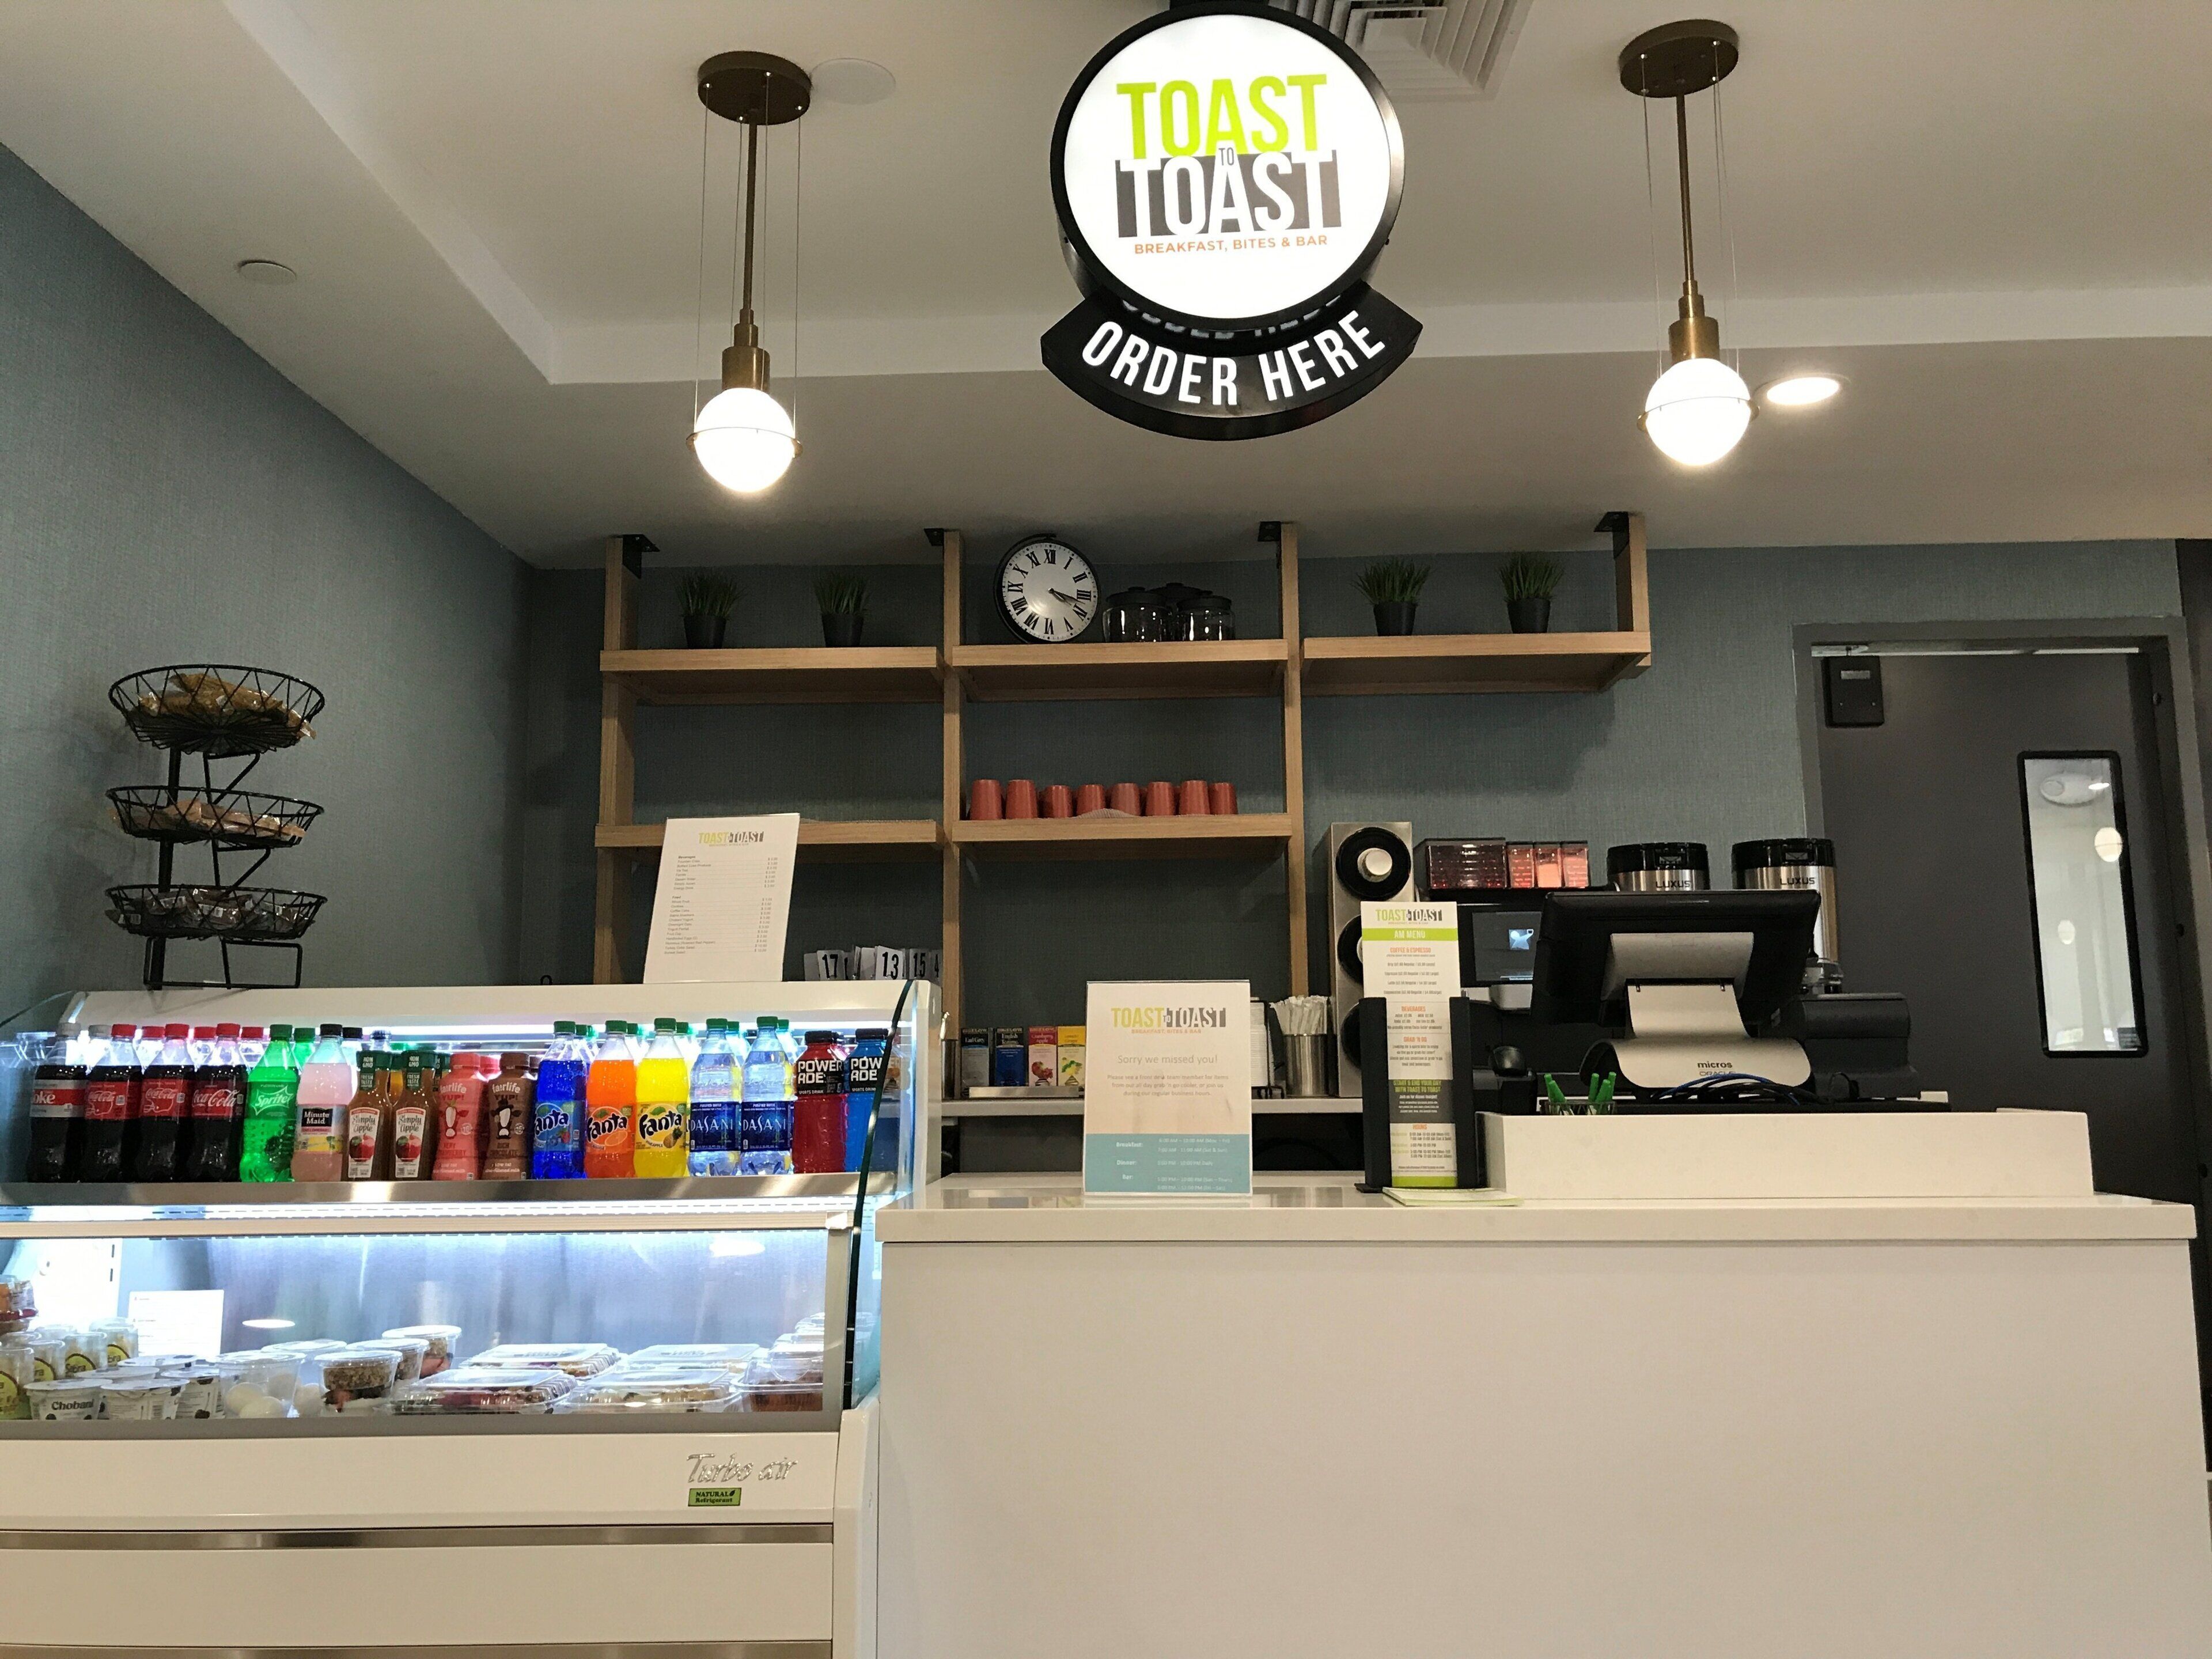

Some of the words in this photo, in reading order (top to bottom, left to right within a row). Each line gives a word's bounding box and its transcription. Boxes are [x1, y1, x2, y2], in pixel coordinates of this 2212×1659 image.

[1116, 74, 1327, 159] TOAST
[1218, 147, 1235, 166] TO
[1116, 150, 1340, 237] TOAST
[1134, 239, 1228, 255] BREAKFAST,
[1233, 237, 1277, 251] BITES
[1281, 237, 1290, 247] &
[1296, 234, 1328, 247] BAR
[1082, 321, 1238, 406] ORDER
[1259, 310, 1385, 401] HERE
[1043, 548, 1056, 565] XII
[698, 832, 728, 844] TOAST
[1656, 880, 1691, 888] LUXUS
[1779, 877, 1815, 885] LUXUS
[1375, 909, 1407, 921] TOAST
[1408, 909, 1442, 921] TOAST
[1407, 930, 1426, 938] MENU
[822, 953, 838, 979] 17
[882, 951, 899, 980] 13
[913, 952, 926, 978] 15
[1111, 1007, 1164, 1028] TOAST
[1166, 1007, 1226, 1028] TOAST
[798, 1059, 843, 1073] POWER
[850, 1057, 882, 1070] POW
[1118, 1055, 1141, 1065] Sorry
[1161, 1055, 1194, 1063] missed
[1196, 1055, 1218, 1065] you!
[1697, 1060, 1733, 1069] micros
[798, 1071, 823, 1084] ADE
[850, 1070, 877, 1081] ADE
[492, 1082, 521, 1094] fairlife
[33, 1090, 56, 1104] oke
[255, 1093, 288, 1108] Sprite
[535, 1109, 569, 1135] anta
[639, 1109, 682, 1140] Fanta
[691, 1115, 733, 1134] DASANI
[743, 1115, 786, 1133] DASANI
[107, 1354, 122, 1363] bra
[51, 1398, 94, 1411] Chobani
[686, 1452, 754, 1483] Turbo
[758, 1455, 798, 1480] air
